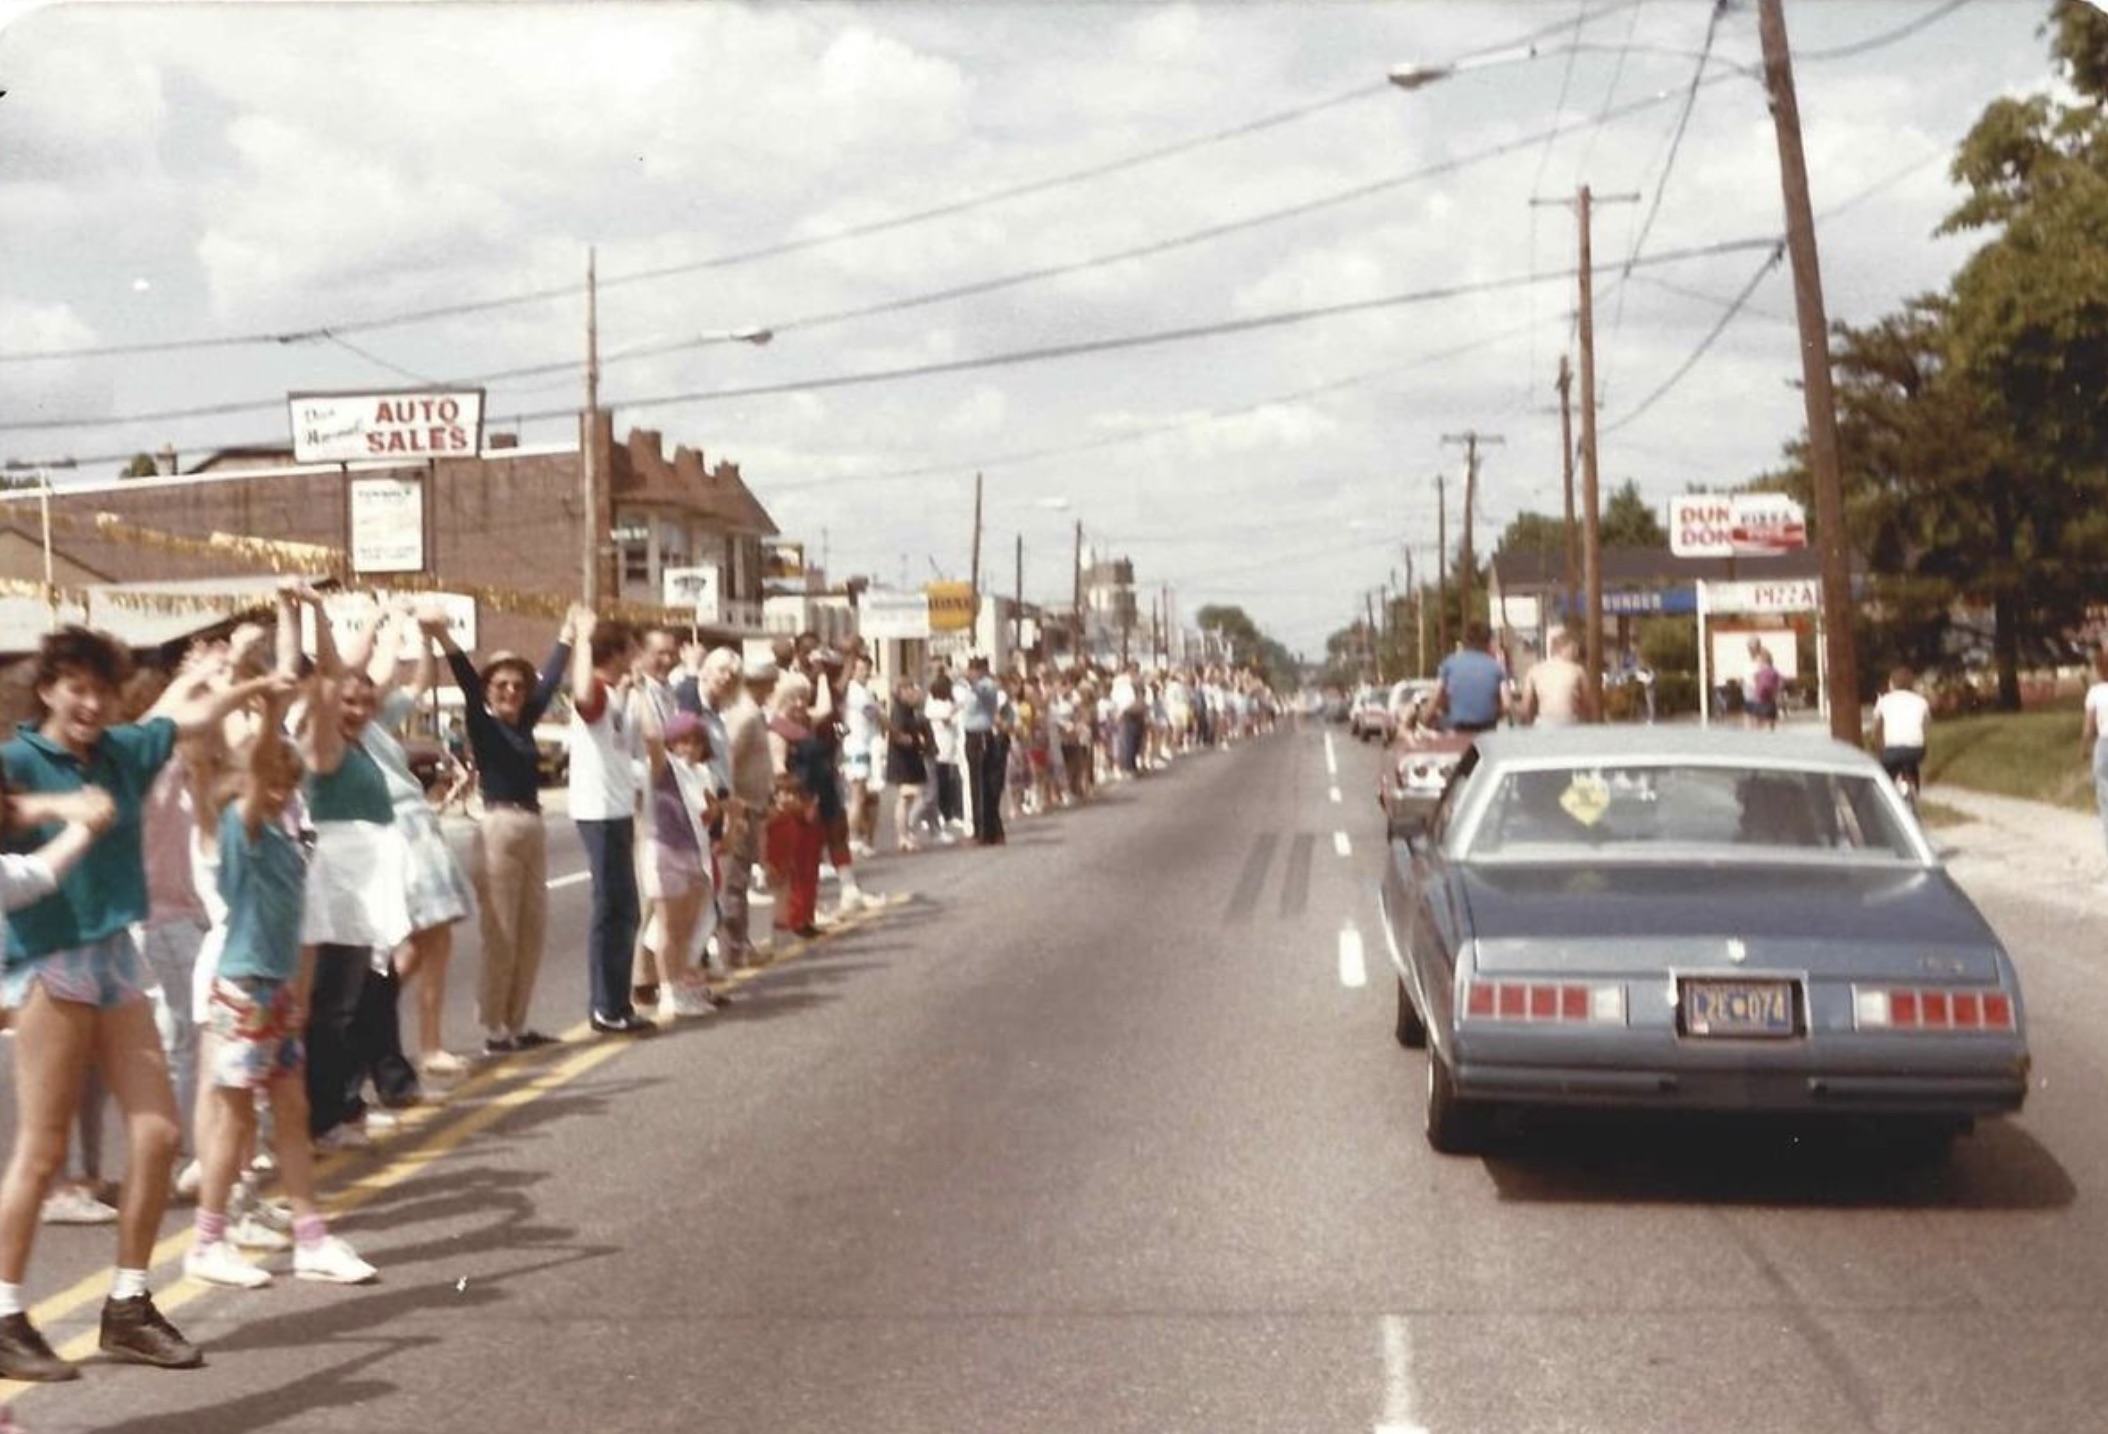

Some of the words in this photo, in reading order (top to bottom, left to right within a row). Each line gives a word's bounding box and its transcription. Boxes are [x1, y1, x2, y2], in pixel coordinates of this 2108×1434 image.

[375, 400, 459, 424] AUTO
[366, 427, 468, 452] SALES
[1680, 507, 1729, 523] DUN
[1755, 586, 1814, 605] PIZZA
